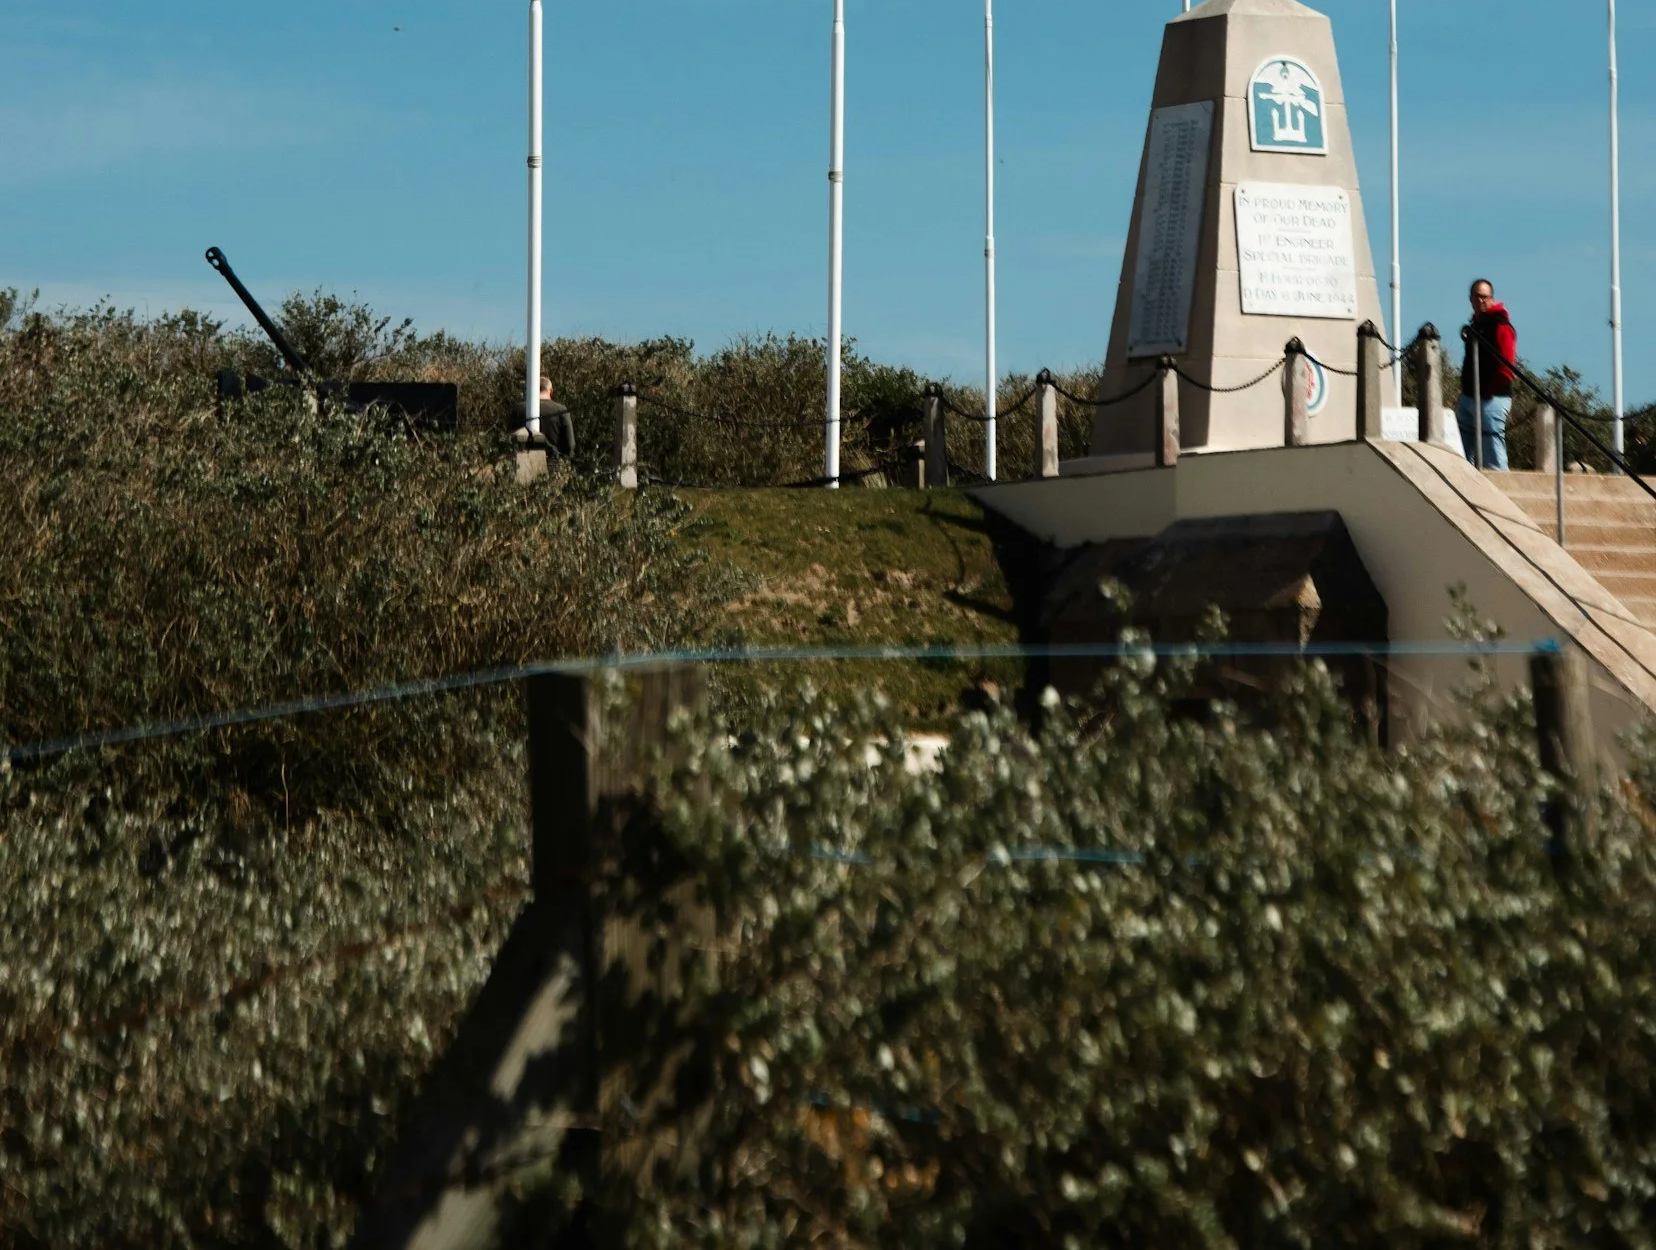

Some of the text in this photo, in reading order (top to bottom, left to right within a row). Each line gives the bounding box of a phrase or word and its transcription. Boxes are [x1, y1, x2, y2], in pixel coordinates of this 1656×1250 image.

[1254, 198, 1296, 210] PROUD
[1299, 199, 1348, 213] MEMORY
[1253, 212, 1336, 229] OF OUR DEAD
[1276, 235, 1335, 249] ENGINEER
[1243, 250, 1350, 267] SPECIAL BRIGADE
[1255, 288, 1277, 300] DAY
[1293, 291, 1326, 303] JUNE
